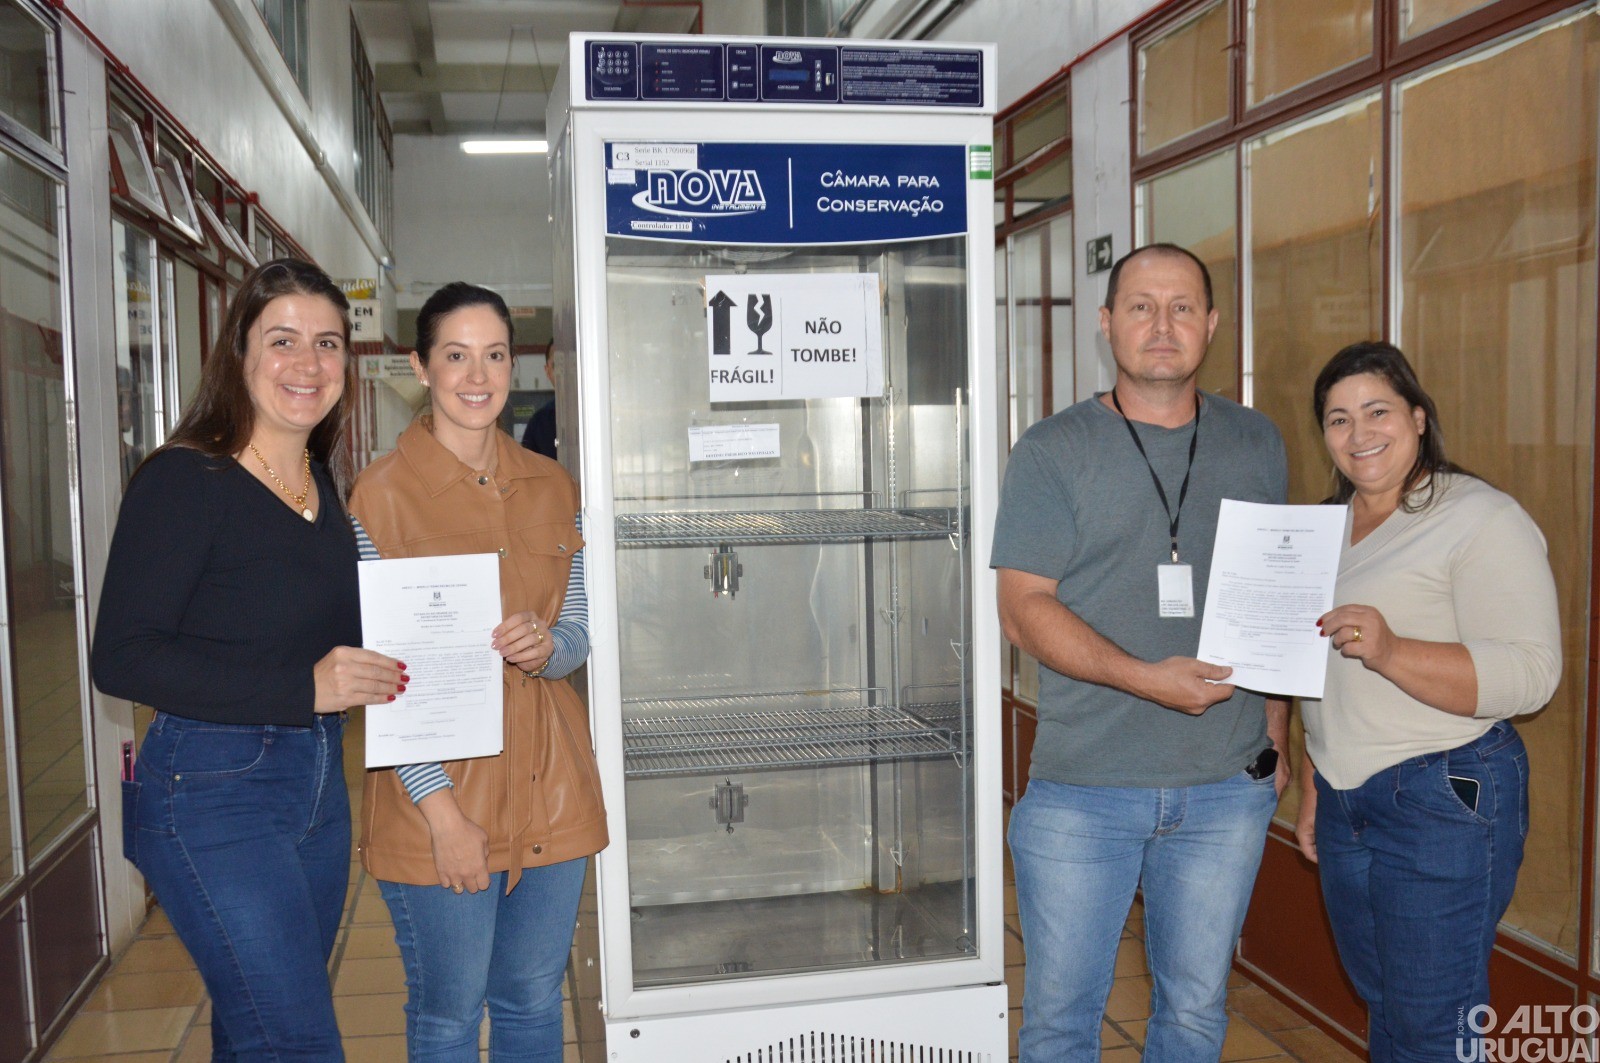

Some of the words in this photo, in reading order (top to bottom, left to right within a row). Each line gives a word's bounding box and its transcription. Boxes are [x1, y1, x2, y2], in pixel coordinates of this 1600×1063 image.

[616, 152, 630, 160] C3
[354, 306, 373, 317] EM
[805, 317, 842, 335] NÃO
[790, 348, 857, 362] TOMBE!
[710, 366, 775, 384] FRÁGIL!
